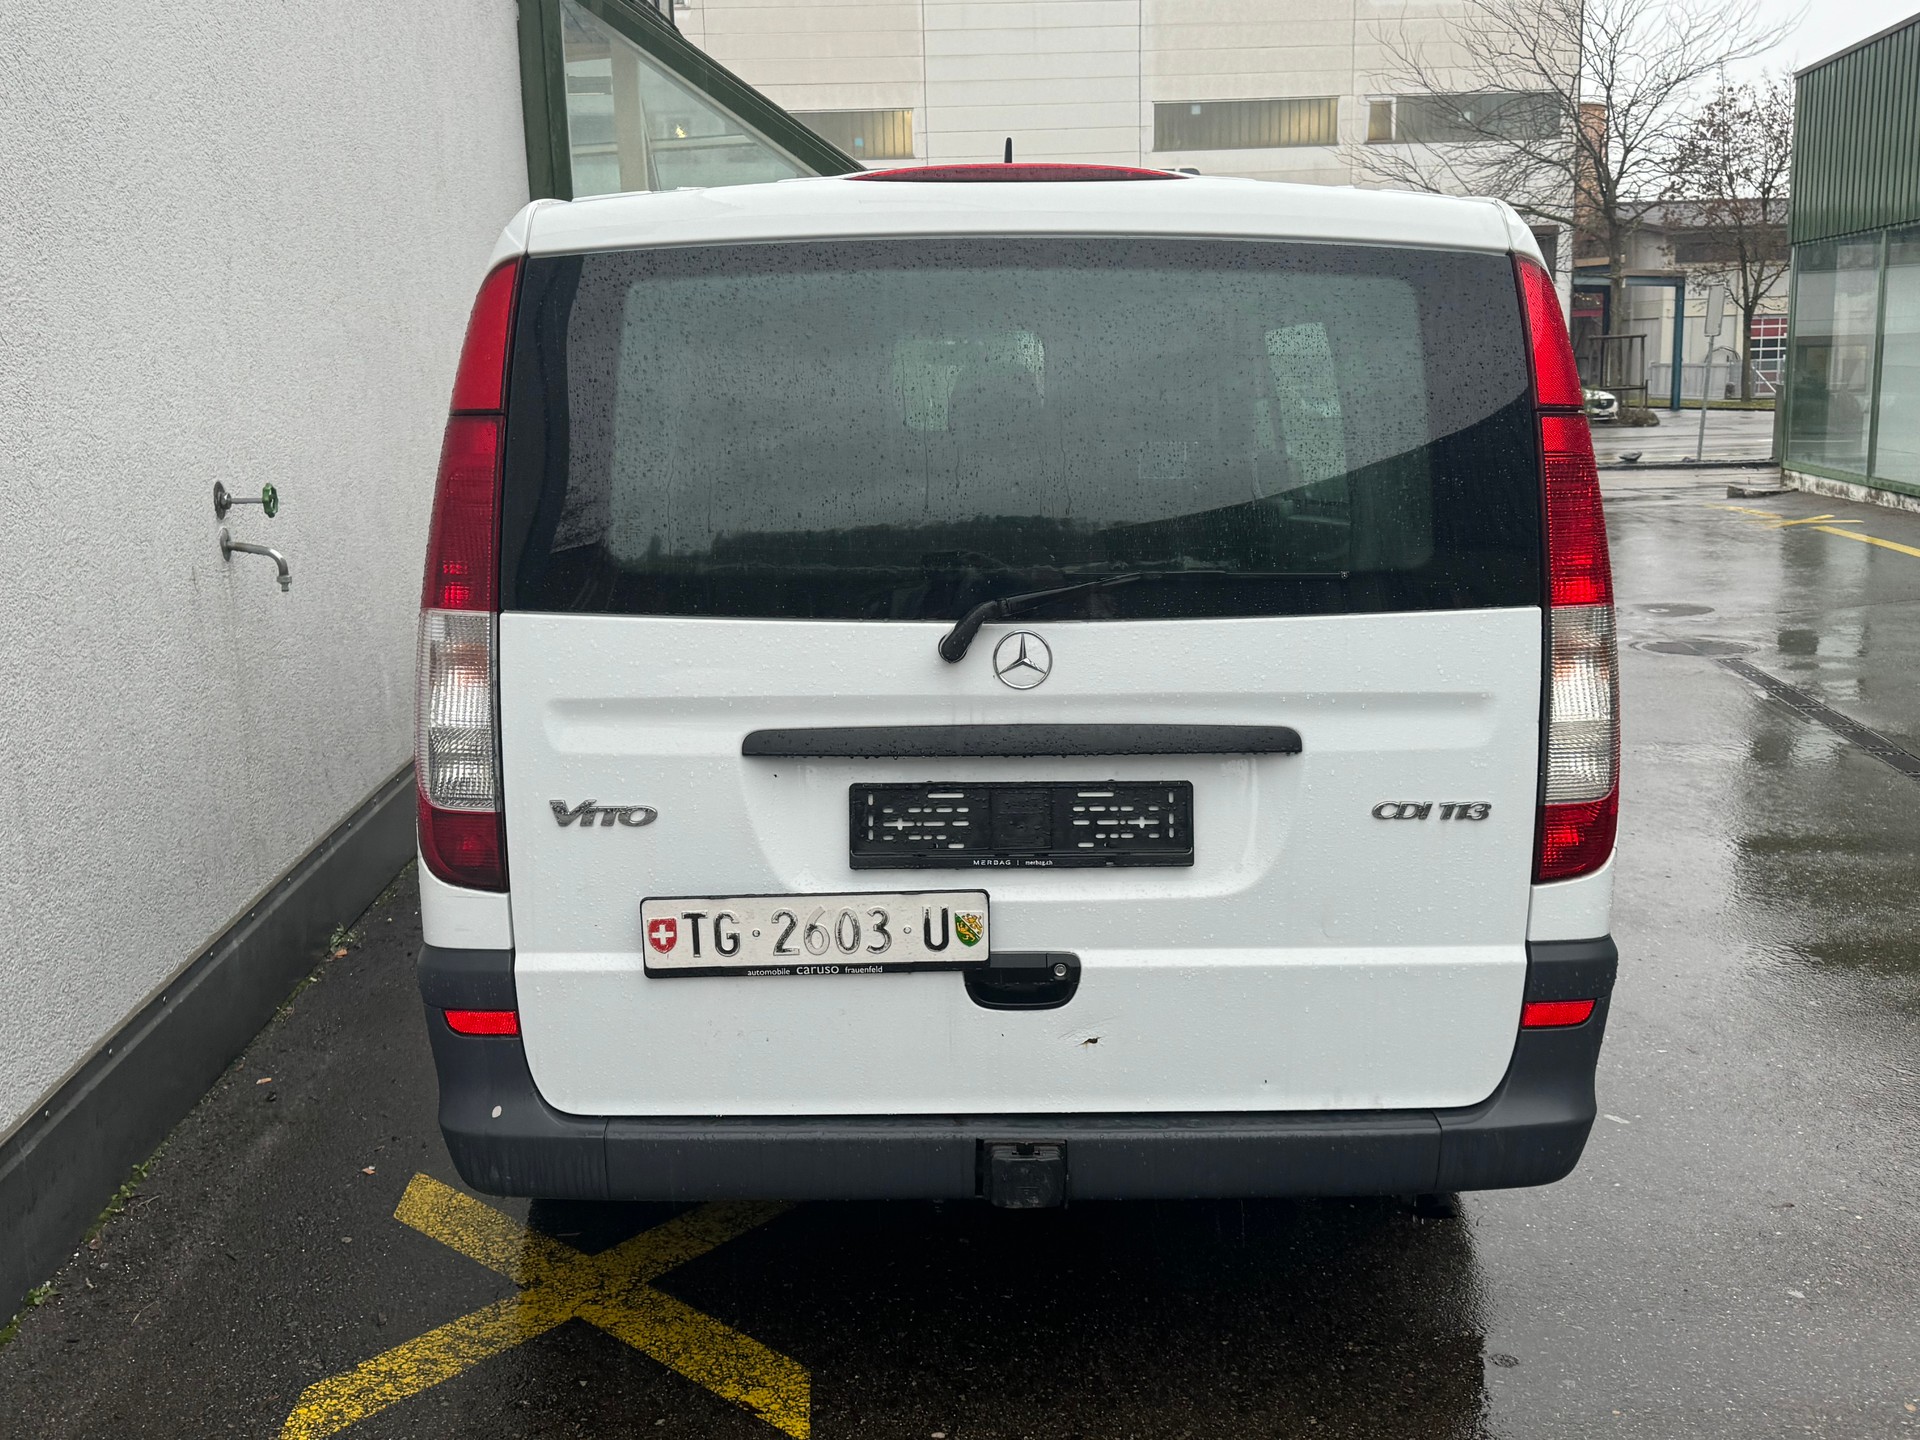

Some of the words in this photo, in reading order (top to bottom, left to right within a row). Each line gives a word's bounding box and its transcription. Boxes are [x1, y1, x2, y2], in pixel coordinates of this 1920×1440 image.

[1371, 801, 1433, 820] CDI
[1439, 801, 1492, 820] 113
[681, 910, 741, 958] TG
[771, 904, 893, 956] 2603
[922, 905, 950, 952] U
[747, 968, 791, 976] automobile
[796, 965, 840, 975] caruso
[844, 965, 883, 974] frauenfeld
